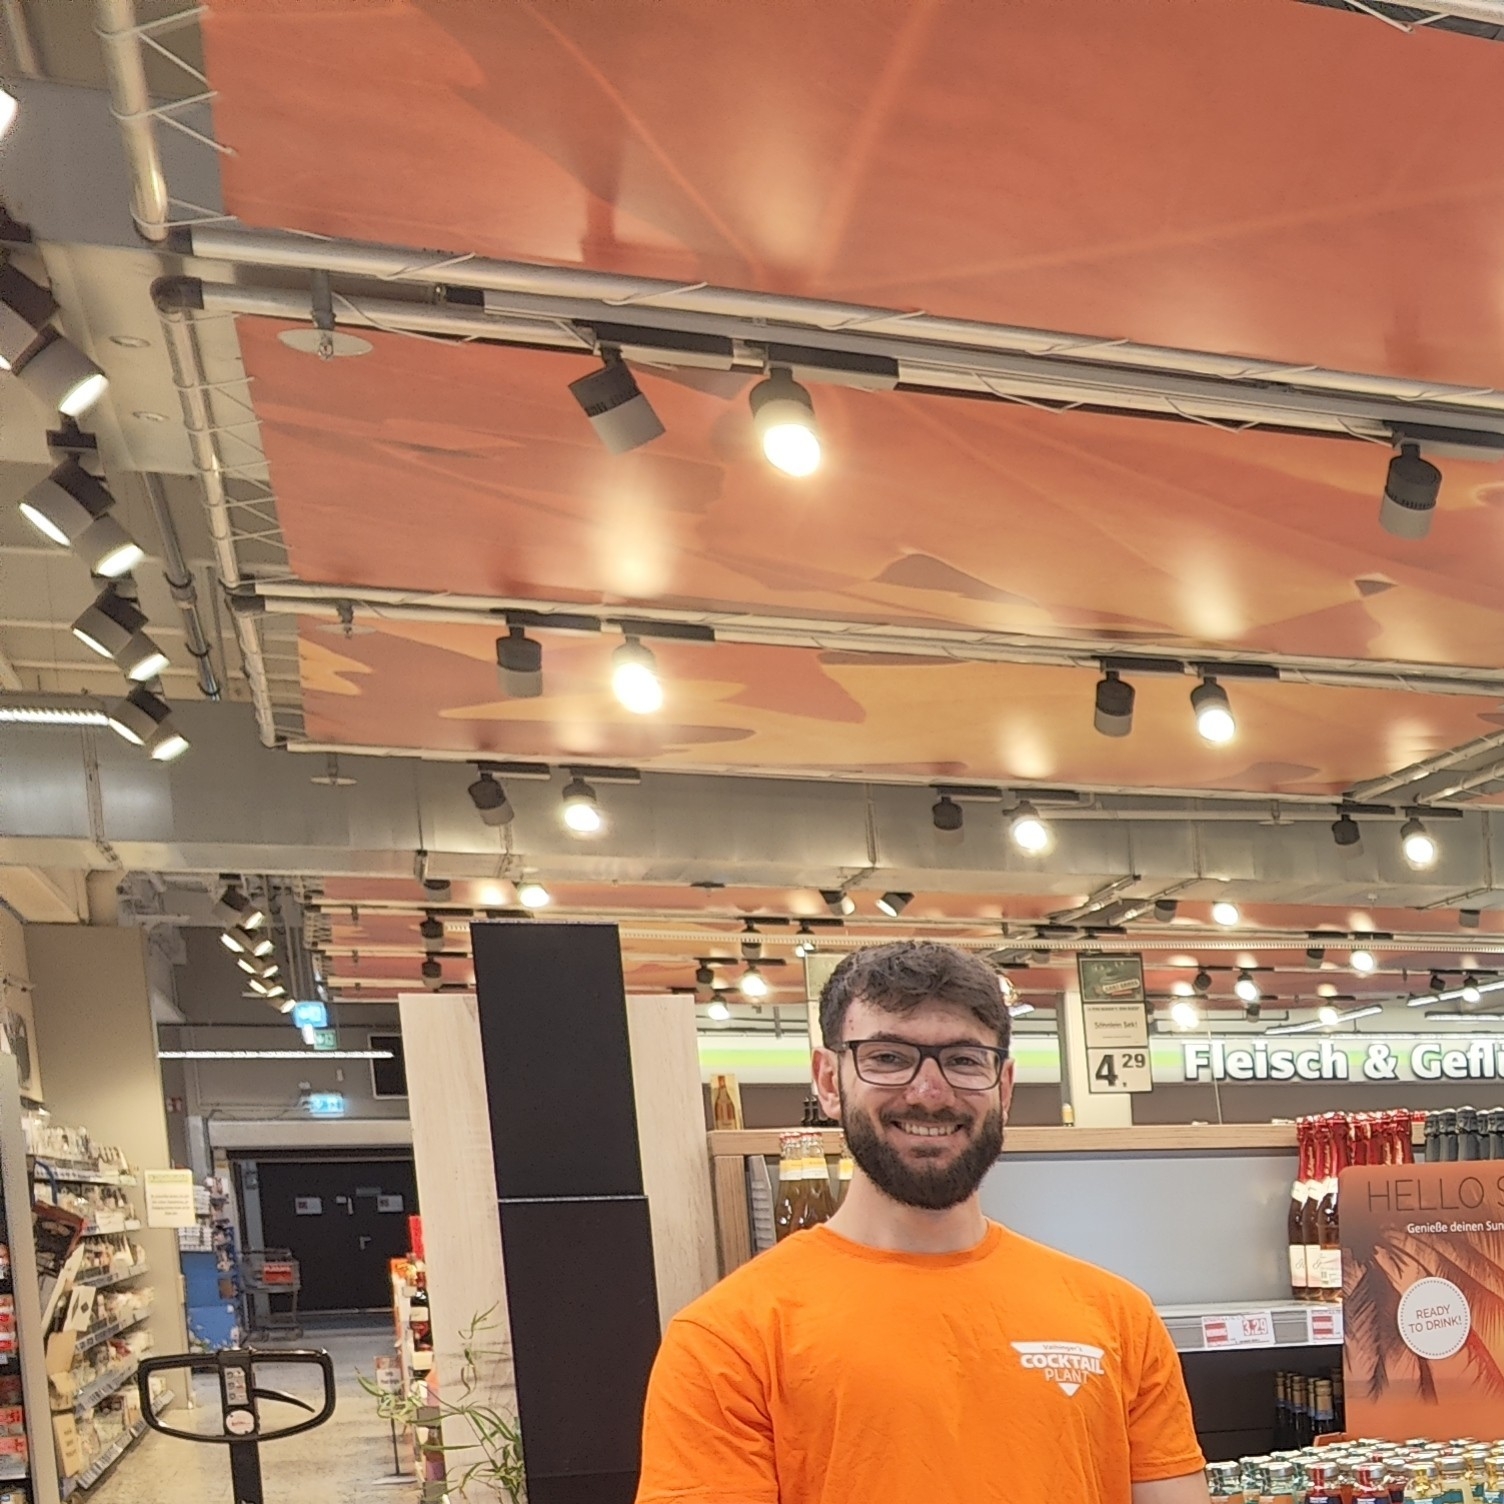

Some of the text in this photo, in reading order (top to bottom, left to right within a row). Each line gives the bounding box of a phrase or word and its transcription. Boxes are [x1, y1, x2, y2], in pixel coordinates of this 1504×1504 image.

[1182, 1041, 1350, 1080] Fleisch
[1363, 1043, 1400, 1080] &
[1367, 1177, 1485, 1212] HELLO
[1406, 1221, 1448, 1235] Genieße
[1450, 1220, 1484, 1233] deinen
[1415, 1303, 1451, 1320] READY
[1242, 1317, 1269, 1336] 3.29
[1408, 1314, 1462, 1334] TO DRINK!
[1020, 1353, 1105, 1375] COCKTAIL
[1044, 1367, 1090, 1385] PLANT
